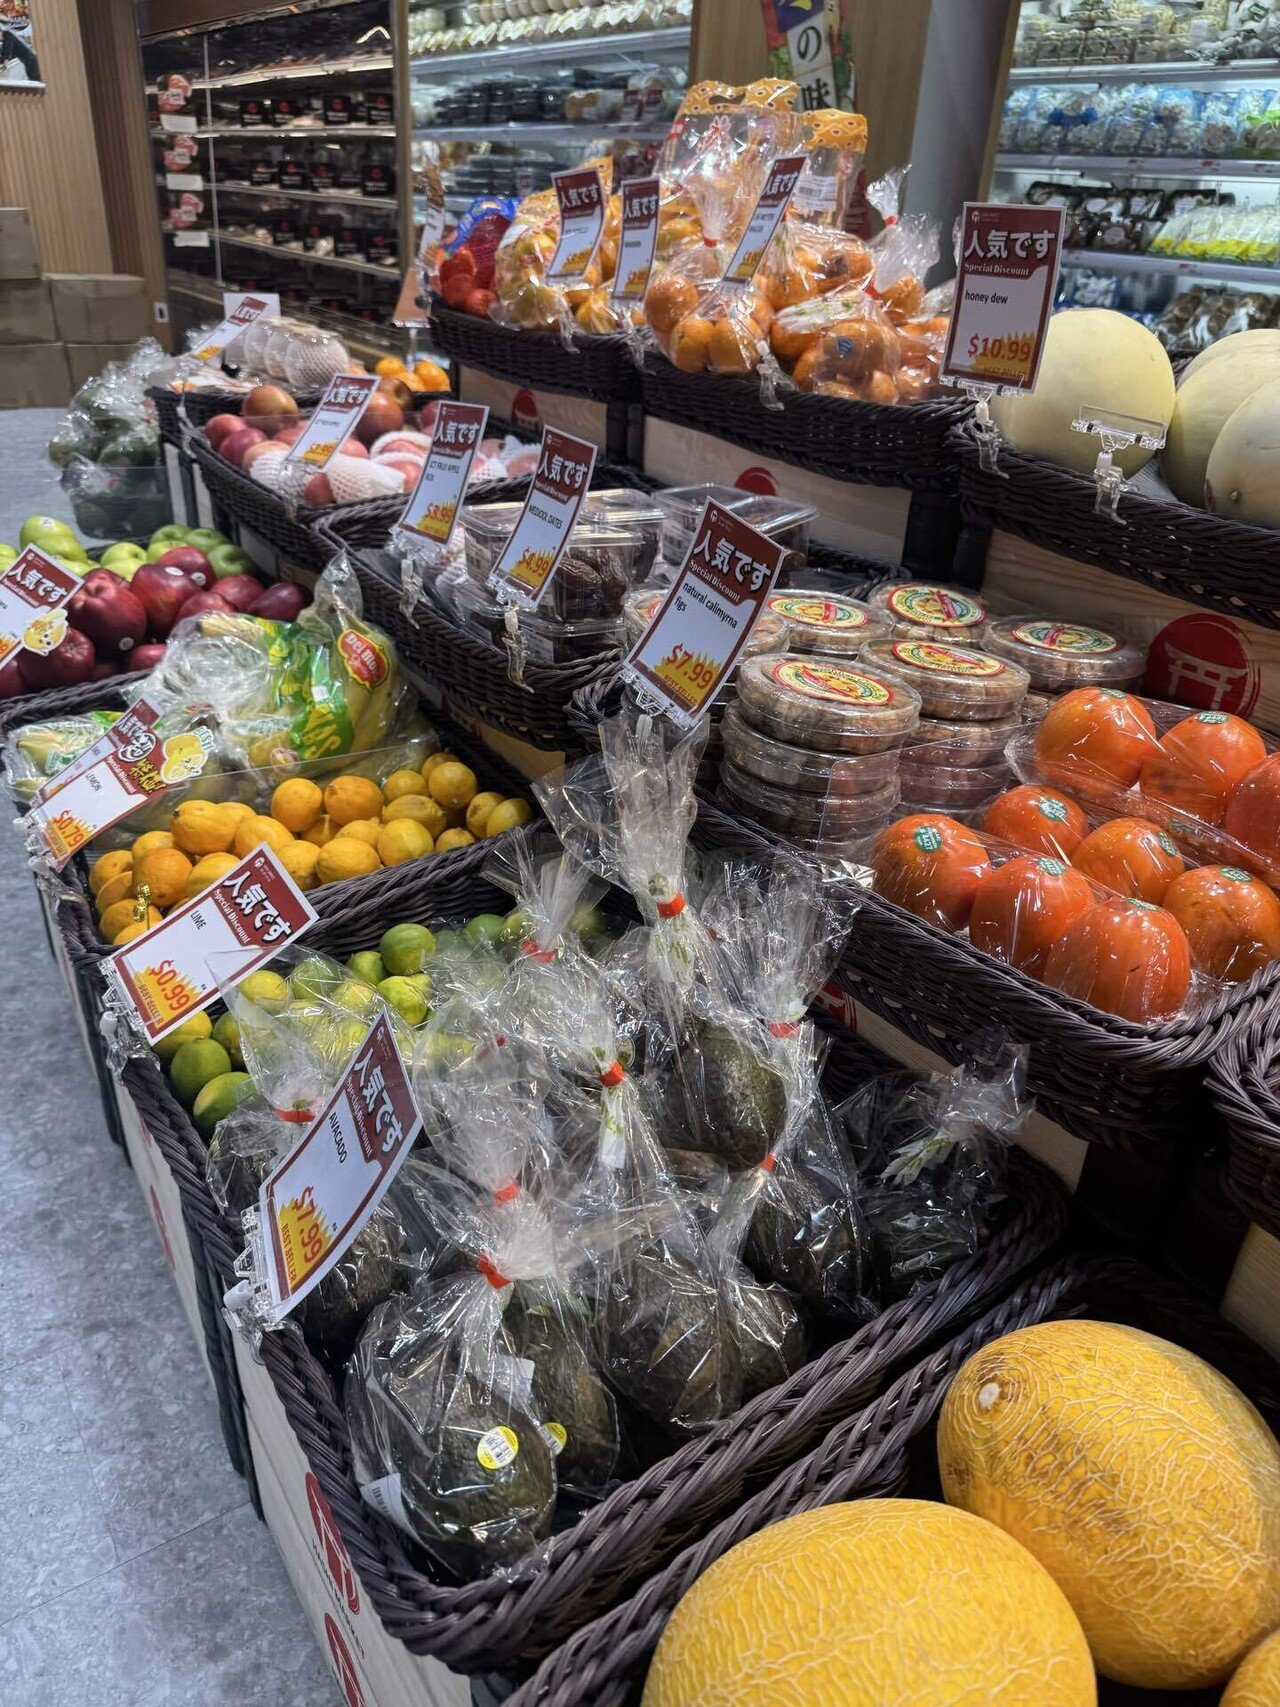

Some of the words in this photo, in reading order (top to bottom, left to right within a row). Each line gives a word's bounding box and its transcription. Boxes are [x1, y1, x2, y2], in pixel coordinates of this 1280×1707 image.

[964, 229, 1056, 260] 人気です
[965, 263, 993, 274] Special
[993, 265, 1030, 276] Discount
[965, 290, 990, 305] honey
[990, 292, 1009, 304] dew
[967, 333, 1032, 363] $10.99
[433, 421, 480, 445] 人気です
[537, 450, 589, 488] 人気です
[547, 515, 563, 530] DATES
[519, 546, 550, 577] $4.99
[693, 530, 772, 591] 人気です
[8, 562, 68, 603] 人気です
[688, 560, 712, 586] Special
[711, 577, 741, 603] Discount
[674, 596, 688, 612] figs
[682, 582, 708, 605] natural
[705, 599, 738, 629] calimyrna
[345, 633, 367, 655] Del
[666, 643, 713, 690] $7.99
[86, 772, 102, 792] LEMON
[51, 809, 84, 847] $0.79
[190, 910, 207, 931] LIME
[213, 888, 231, 920] Special
[227, 911, 252, 946] Discount
[223, 871, 295, 943] 人気です
[139, 984, 151, 1000] BEST
[149, 959, 190, 1011] $0.99
[354, 1046, 403, 1153] 人気です
[328, 1111, 348, 1164] AVACADO
[358, 1108, 373, 1158] Discount
[281, 1223, 292, 1249] BEST
[292, 1186, 323, 1263] $7.99
[285, 1248, 298, 1281] SELLER
